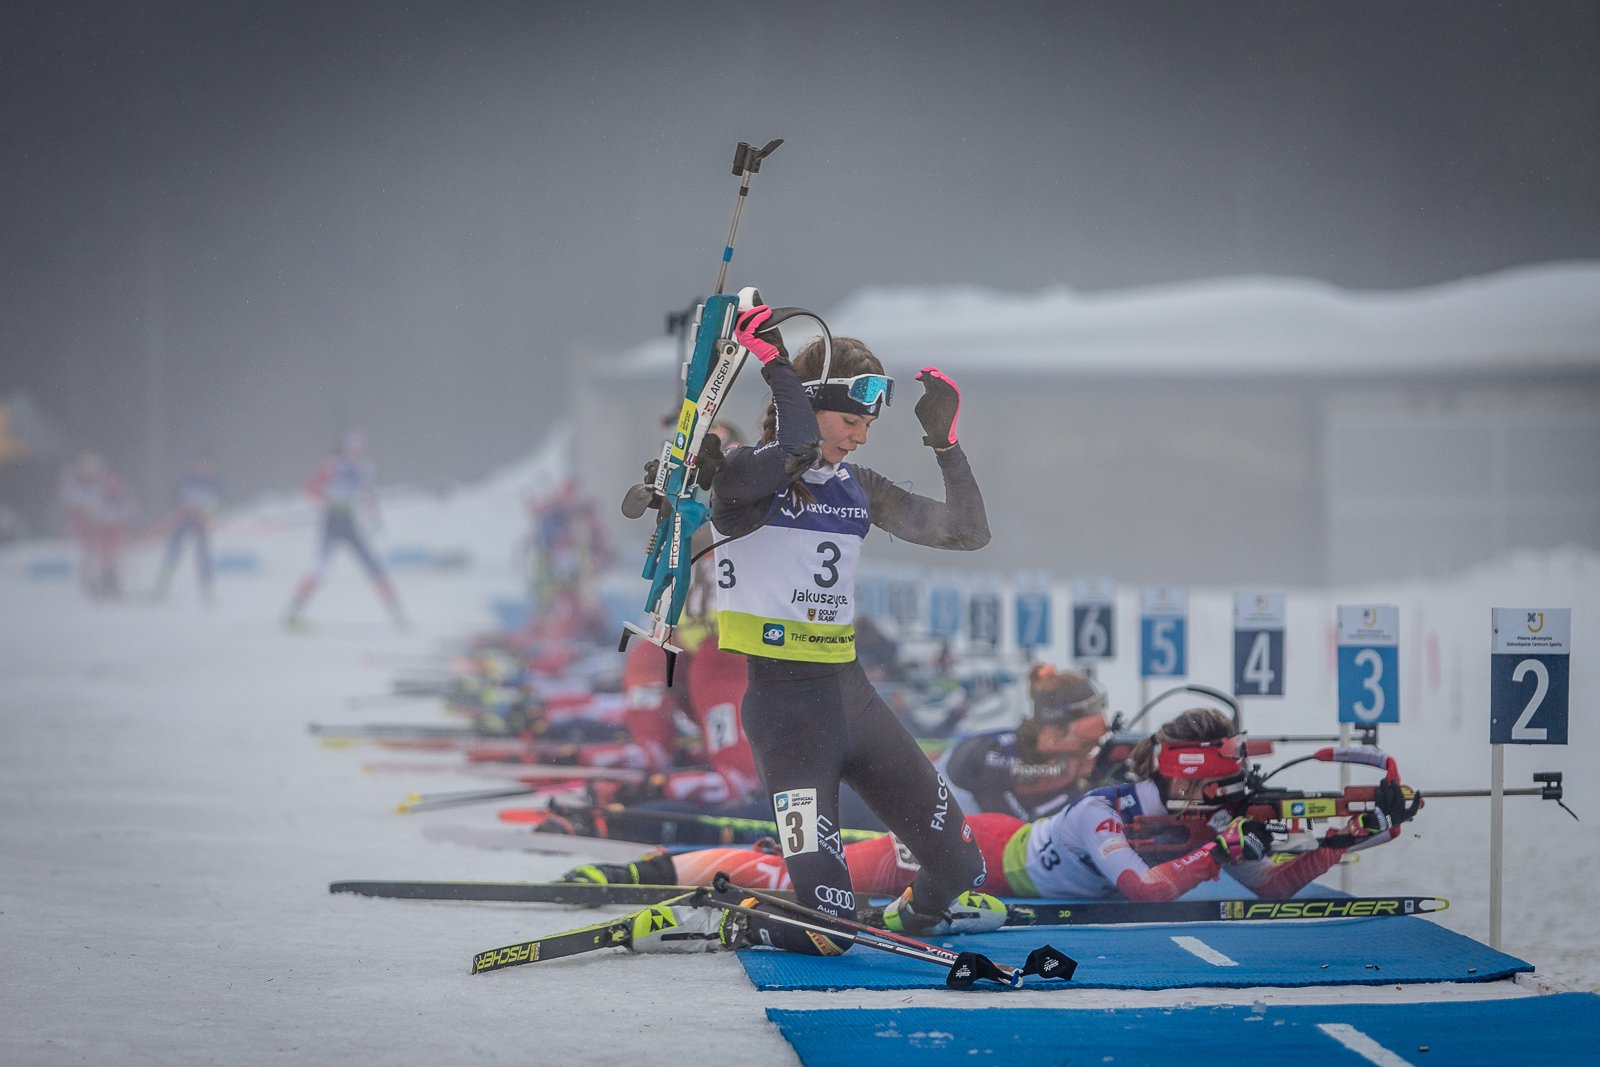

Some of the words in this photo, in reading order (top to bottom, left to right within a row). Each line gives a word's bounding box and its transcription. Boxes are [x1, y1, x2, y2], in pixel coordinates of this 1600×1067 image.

[707, 359, 730, 401] LARSEN
[656, 445, 672, 488] SÜDROL
[806, 503, 869, 519] RYOYSTEM
[718, 559, 736, 589] 3
[814, 541, 841, 589] 3
[791, 589, 848, 608] Jakuszyce
[790, 633, 807, 642] THE
[1078, 610, 1107, 655] 6
[1152, 618, 1177, 674] 5
[1244, 632, 1275, 694] 4
[1353, 648, 1385, 720] 3
[1511, 658, 1550, 740] 2
[785, 811, 803, 854] 3
[817, 814, 845, 856] EA
[1039, 835, 1061, 871] 13
[817, 904, 838, 917] Audi
[1058, 910, 1071, 918] 3D
[1245, 900, 1399, 919] FISCHER
[477, 944, 531, 969] FISCHER
